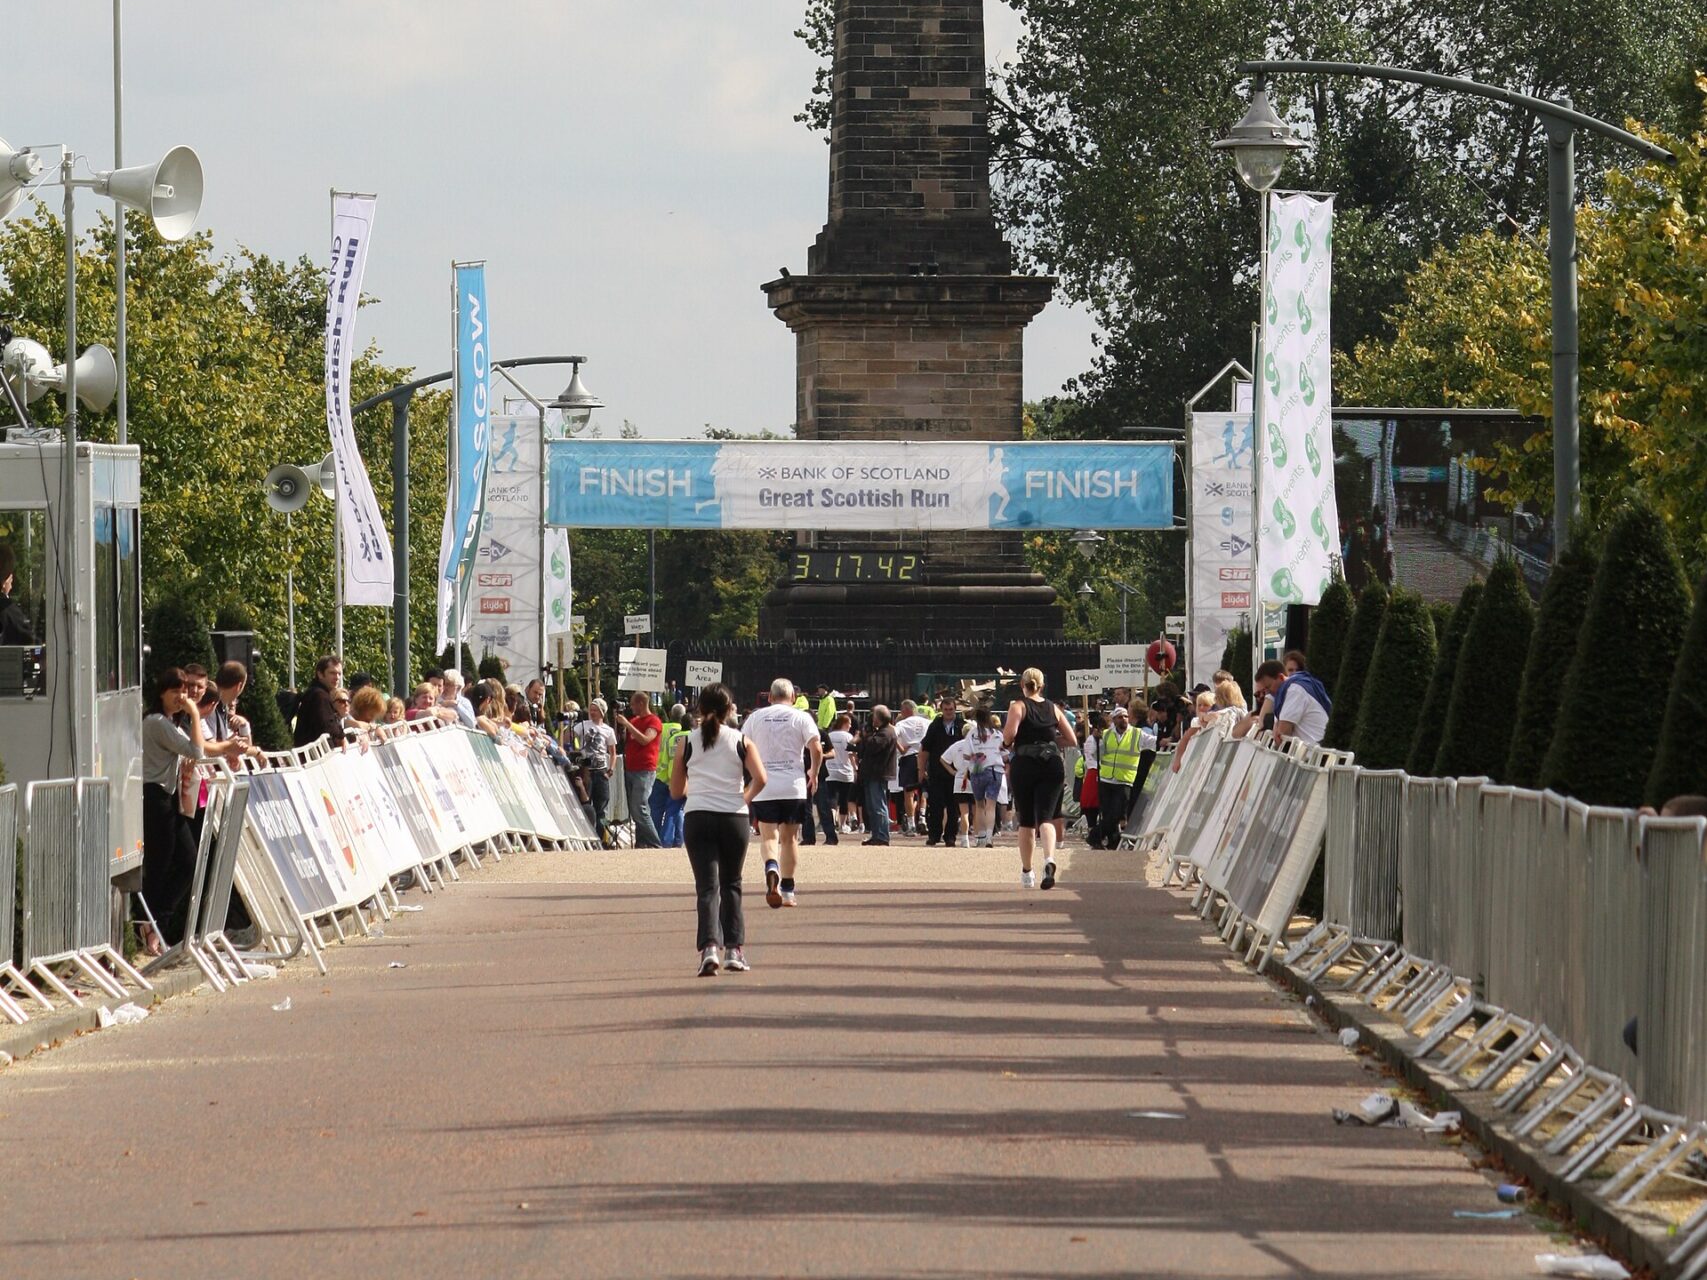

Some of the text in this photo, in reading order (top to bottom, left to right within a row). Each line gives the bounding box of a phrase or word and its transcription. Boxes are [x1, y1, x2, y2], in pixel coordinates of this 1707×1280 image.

[337, 238, 359, 304] Run
[1303, 258, 1325, 294] events
[579, 467, 691, 497] FINISH
[781, 467, 950, 481] BANK OF SCOTLAND
[1025, 470, 1138, 499] FINISH
[1283, 464, 1305, 499] events
[758, 487, 950, 508] Great Scottish Run
[1289, 536, 1311, 572] events
[480, 575, 512, 586] Sun
[1220, 569, 1251, 580] Sun
[689, 665, 719, 674] De-Chip
[695, 674, 712, 682] Area
[1069, 674, 1099, 682] De-Chip
